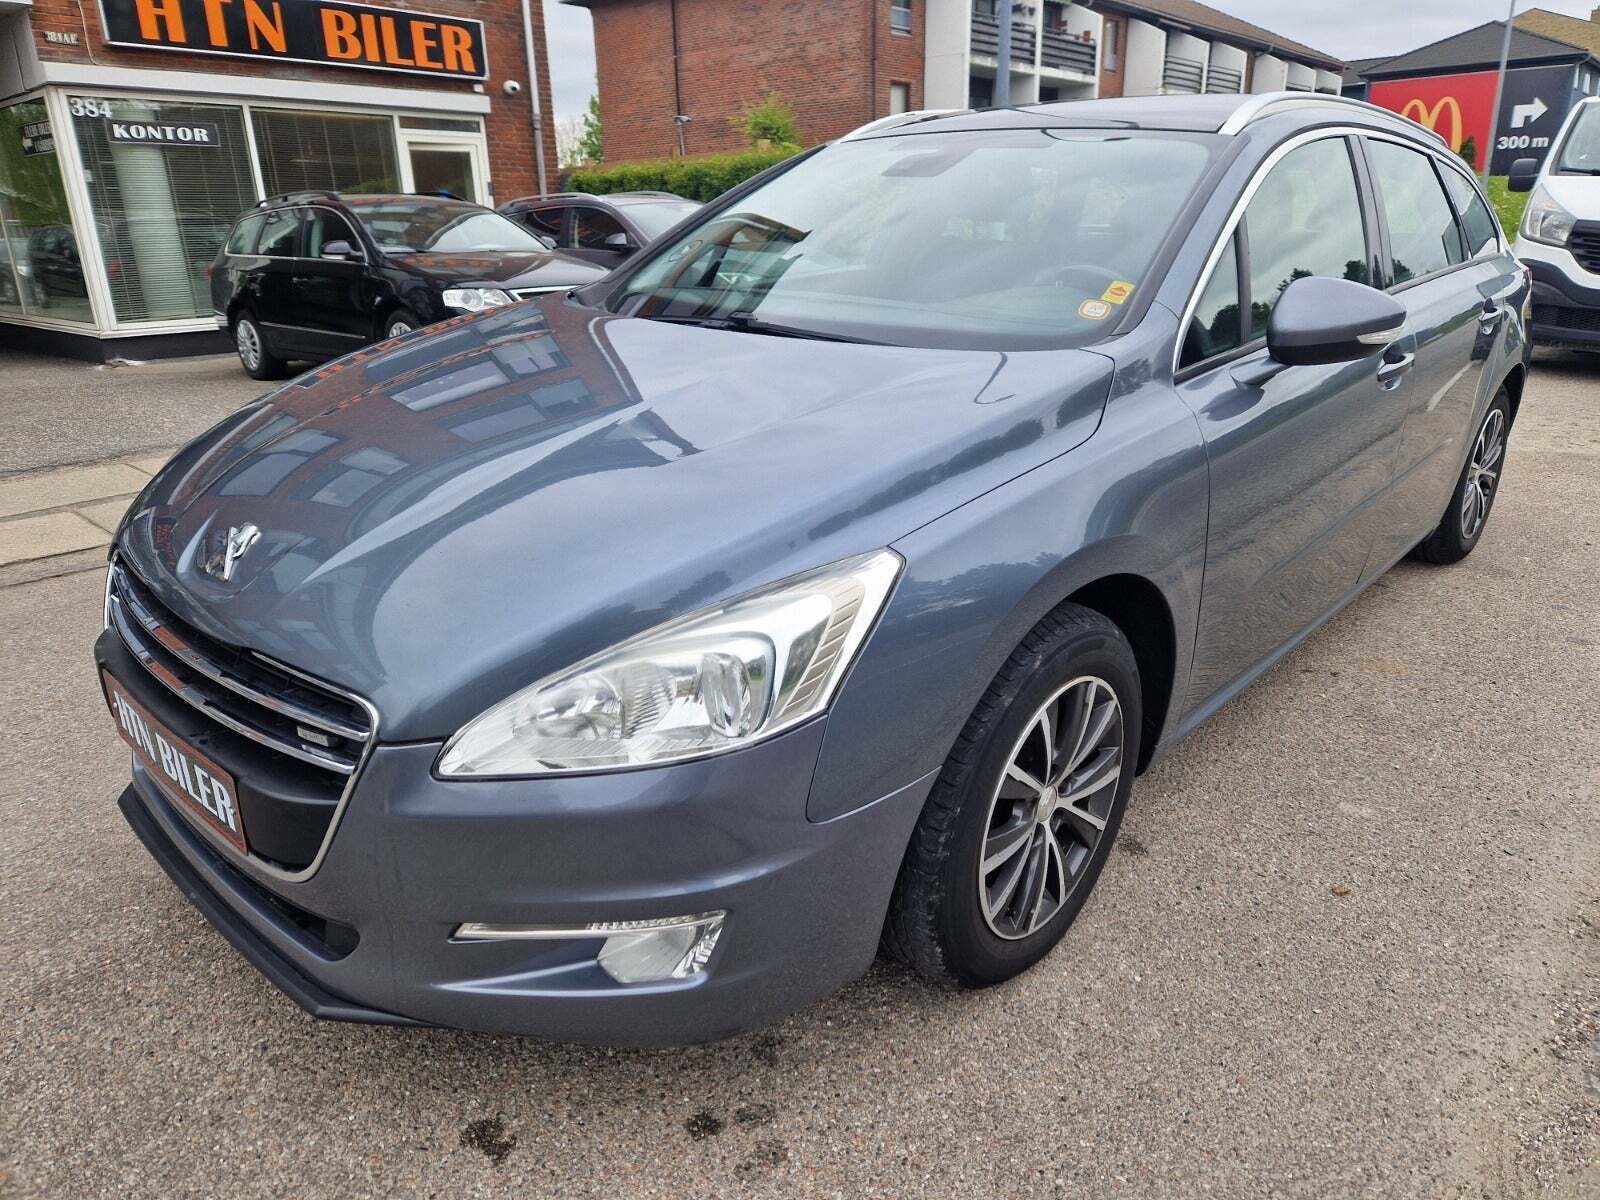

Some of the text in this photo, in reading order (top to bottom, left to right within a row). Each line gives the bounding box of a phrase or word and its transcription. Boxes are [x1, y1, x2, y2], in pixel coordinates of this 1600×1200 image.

[136, 0, 476, 73] HTN BILER
[70, 97, 112, 118] 384
[112, 123, 209, 142] KONTOR
[1496, 135, 1549, 150] 300 m
[113, 690, 236, 832] HTN BILER
